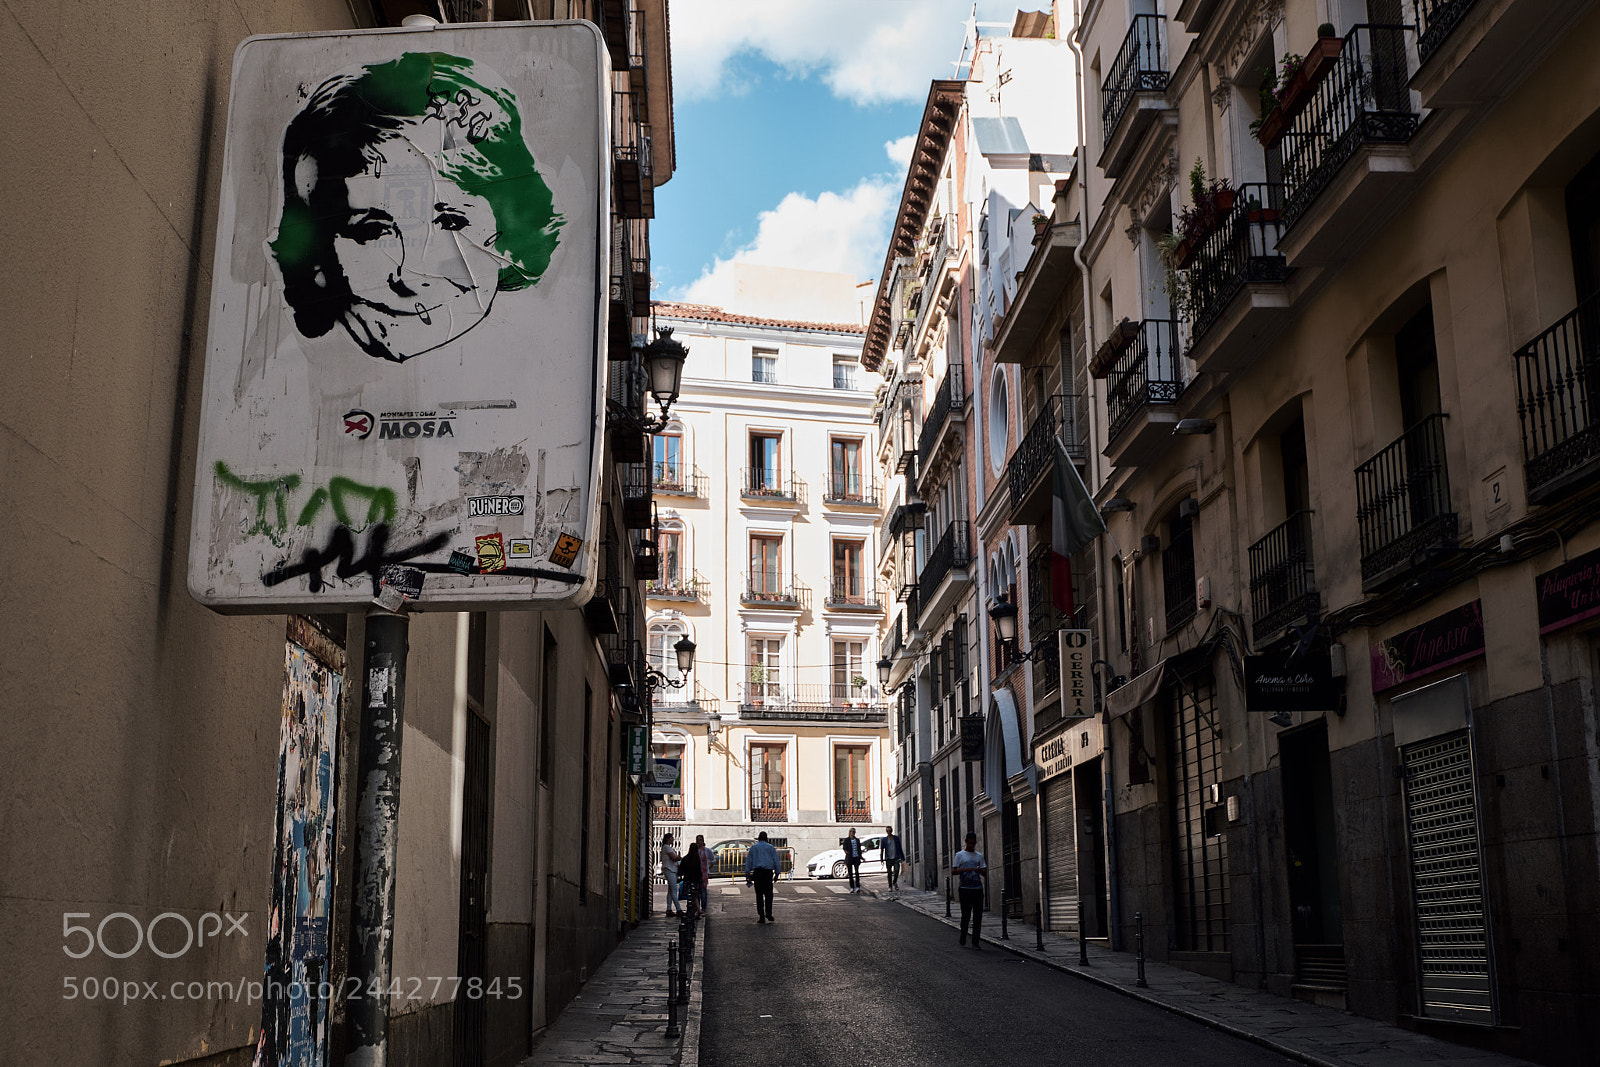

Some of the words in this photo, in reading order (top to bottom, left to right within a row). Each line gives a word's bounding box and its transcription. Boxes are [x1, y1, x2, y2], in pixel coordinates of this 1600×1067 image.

[379, 421, 454, 439] MOSA
[1493, 482, 1501, 504] 2
[1402, 624, 1472, 669] Vanessa
[632, 727, 643, 772] TINTE
